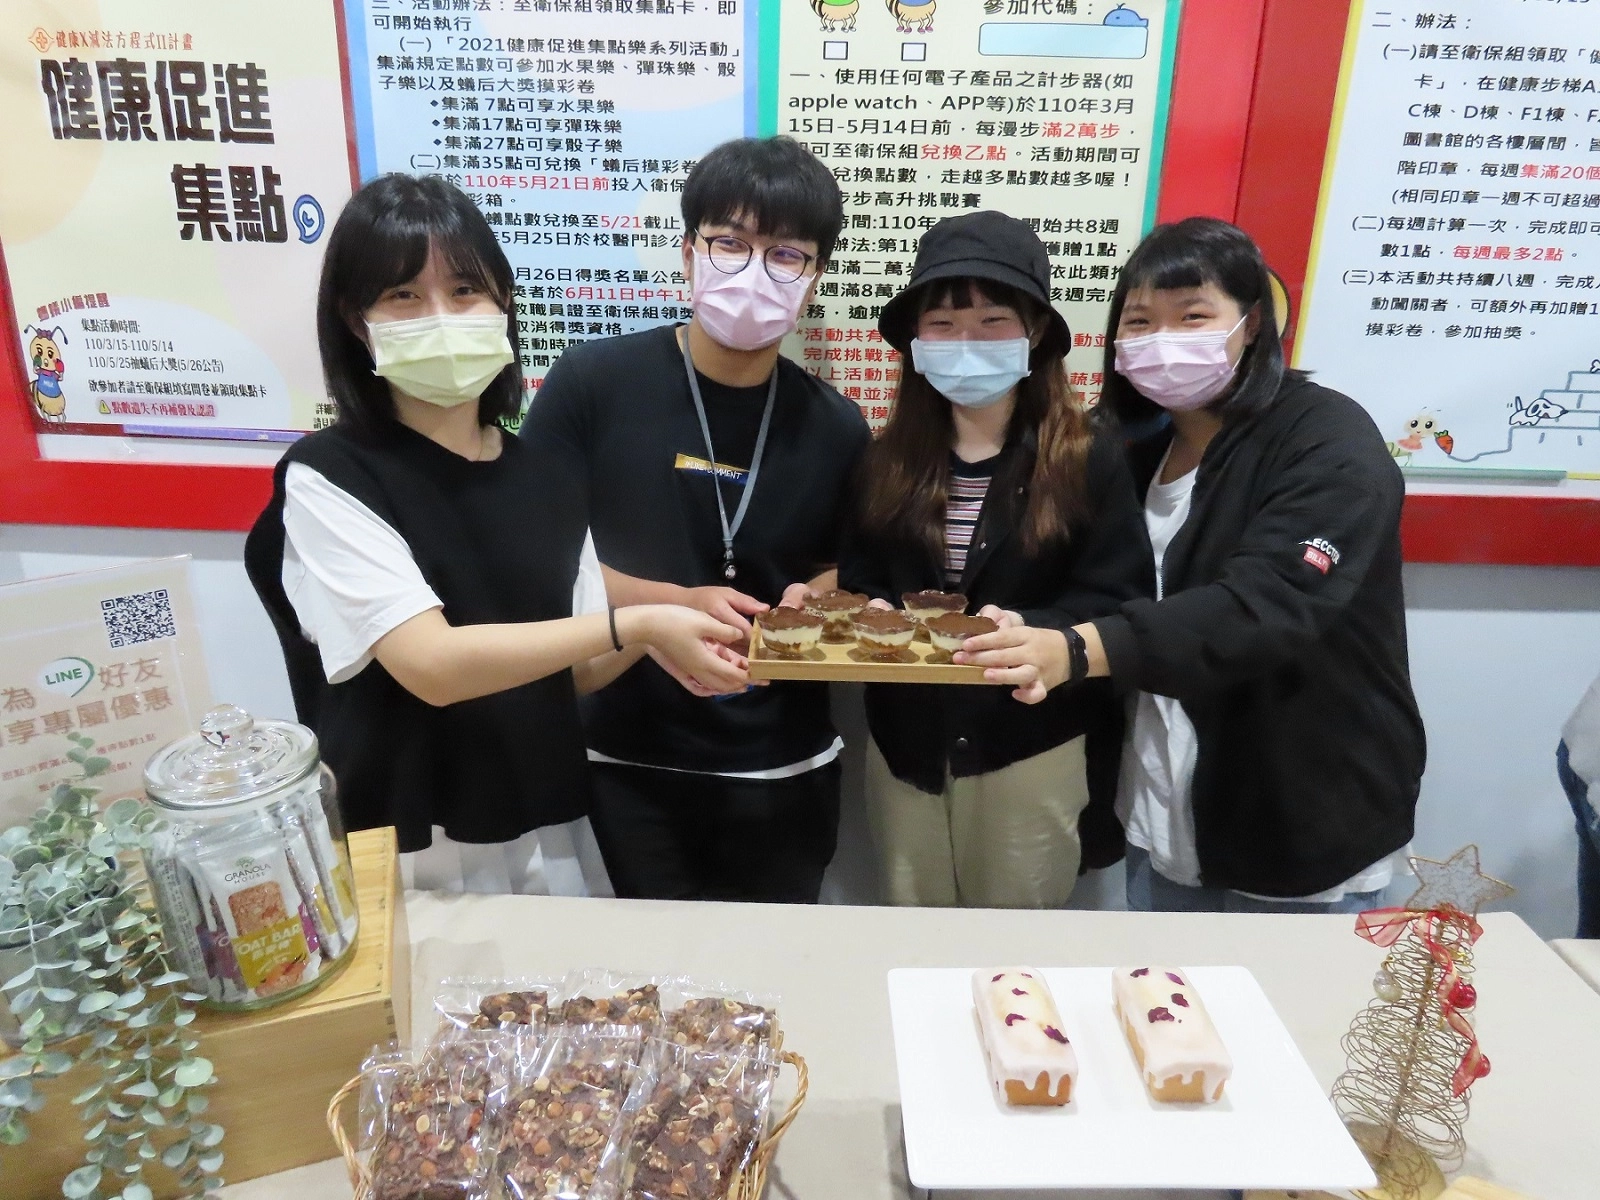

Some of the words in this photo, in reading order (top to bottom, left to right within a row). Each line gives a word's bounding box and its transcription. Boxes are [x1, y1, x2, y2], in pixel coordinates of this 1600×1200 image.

[373, 14, 472, 31] 可開始執行
[1414, 73, 1600, 93] 卡」，在健康步梯A
[40, 57, 275, 145] 健康促進
[788, 94, 848, 112] apple
[1407, 103, 1600, 123] C棟、D棟、F1棟、F
[443, 116, 622, 134] 集滿17點可享彈珠樂
[444, 135, 623, 153] 集滿27點可享骰子樂
[170, 163, 289, 244] 集點
[495, 231, 683, 248] 5月25日於校醫門診公
[1342, 269, 1600, 290] (三)本活動共持續八週，完成
[85, 338, 174, 353] 110/3/15-110/5/14
[45, 668, 83, 685] LINE
[98, 657, 163, 690] 好友
[0, 686, 173, 746] 享專屬優惠
[224, 863, 272, 882] GRANOLA
